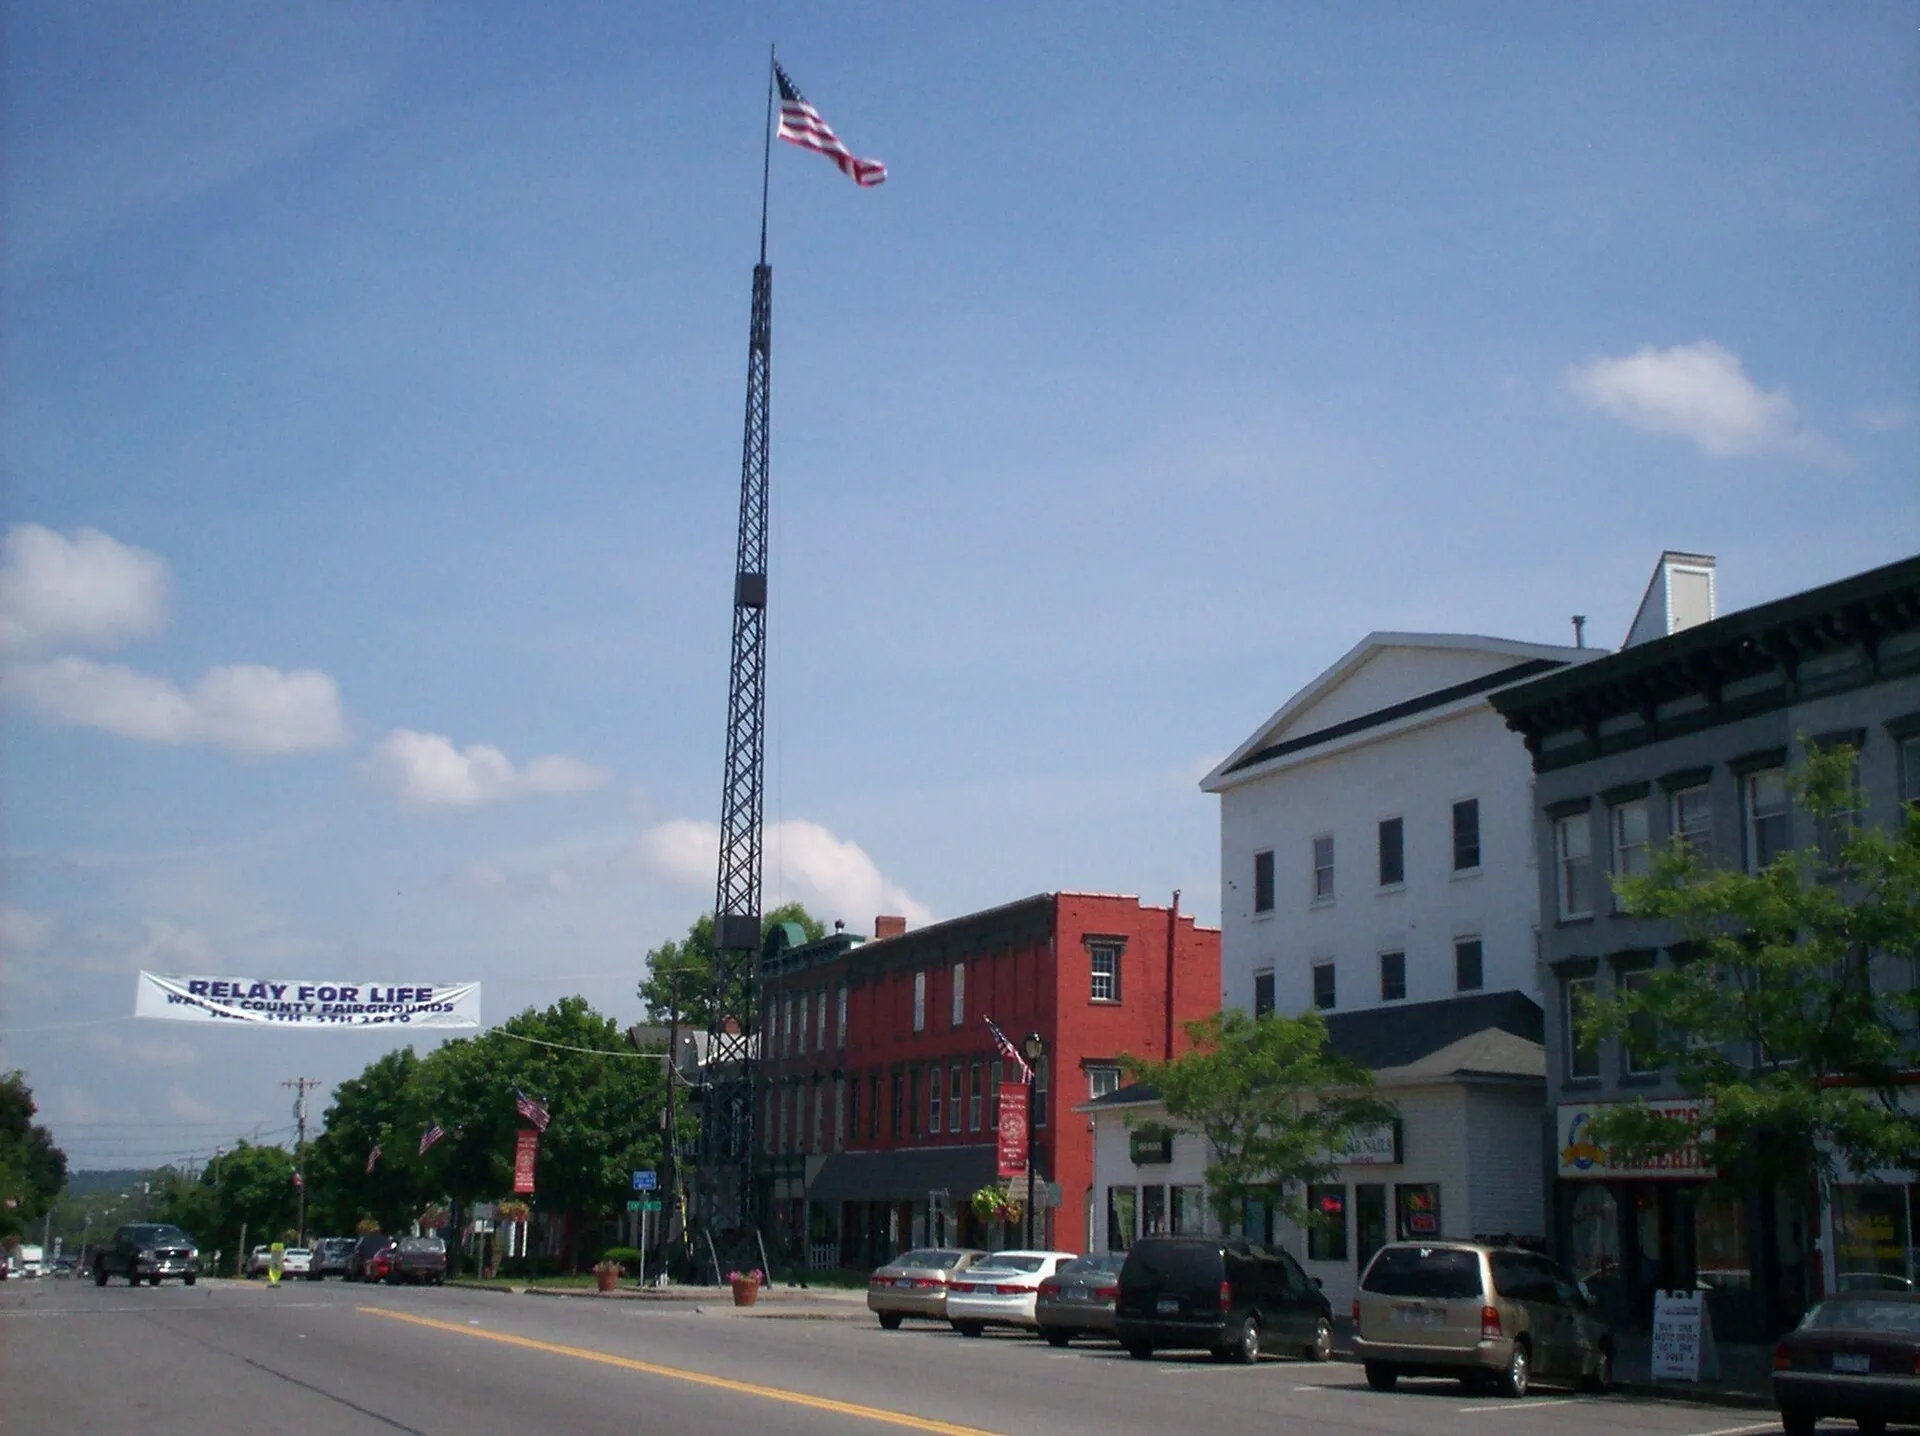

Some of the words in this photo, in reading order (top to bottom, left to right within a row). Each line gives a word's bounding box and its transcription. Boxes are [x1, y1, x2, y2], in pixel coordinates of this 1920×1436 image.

[188, 980, 287, 1000] RELAY
[298, 985, 359, 1002] FOR
[370, 987, 432, 1003] LIFE
[241, 1000, 315, 1013] COUNTY
[322, 1002, 454, 1014] FAIRGROUNDS
